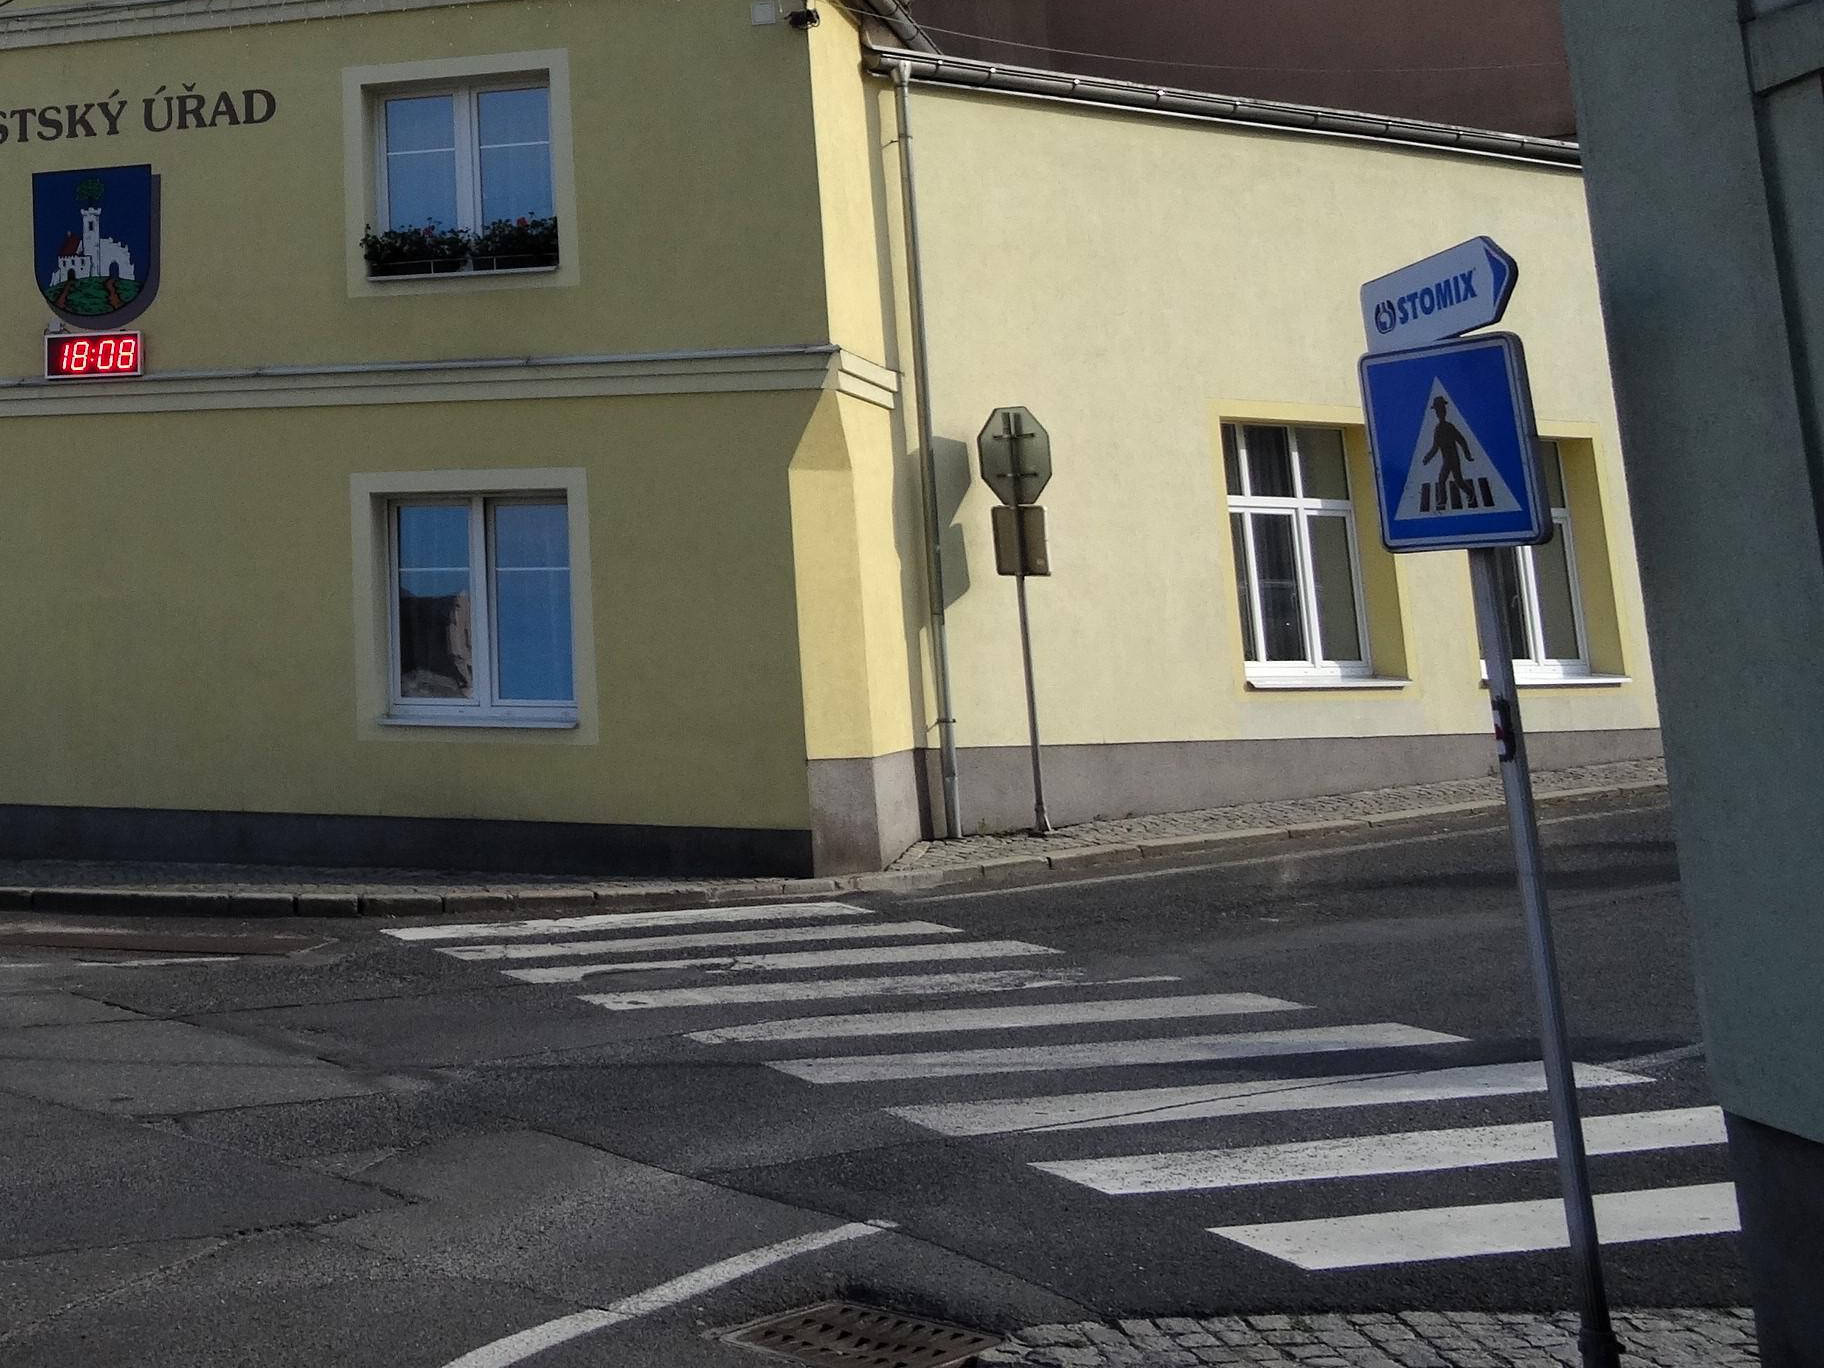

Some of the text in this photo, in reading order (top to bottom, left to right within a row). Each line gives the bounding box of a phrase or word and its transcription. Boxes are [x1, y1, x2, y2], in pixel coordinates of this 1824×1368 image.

[142, 82, 277, 133] ÚŘAD
[1397, 270, 1478, 325] STOMIX
[62, 339, 136, 371] 18:08
